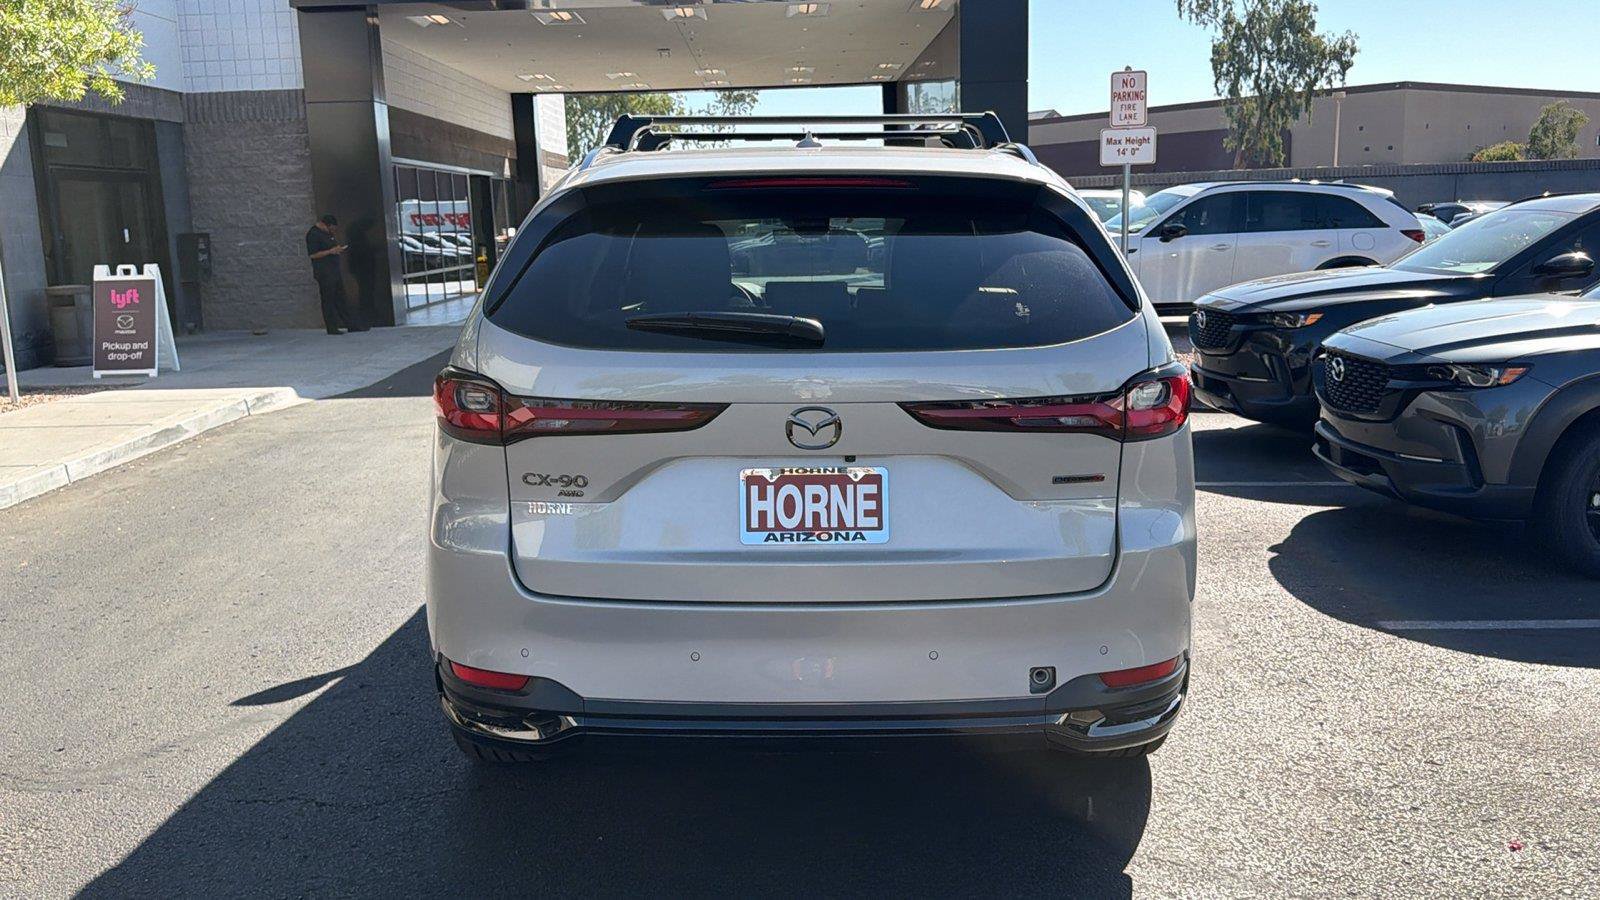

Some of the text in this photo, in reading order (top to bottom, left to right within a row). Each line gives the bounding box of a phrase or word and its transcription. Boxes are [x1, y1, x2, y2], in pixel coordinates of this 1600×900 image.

[1122, 78, 1136, 88] NO
[1113, 90, 1144, 102] PARKING
[1119, 113, 1138, 121] LANE
[1106, 136, 1150, 147] Max Height
[111, 289, 140, 308] lyft
[102, 341, 148, 351] Pickup and
[107, 352, 142, 361] drop-off
[522, 472, 589, 488] CX-90
[558, 489, 585, 498] AWD
[528, 502, 574, 515] HORNE
[750, 484, 878, 530] HORNE
[764, 532, 867, 543] ARIZONA
